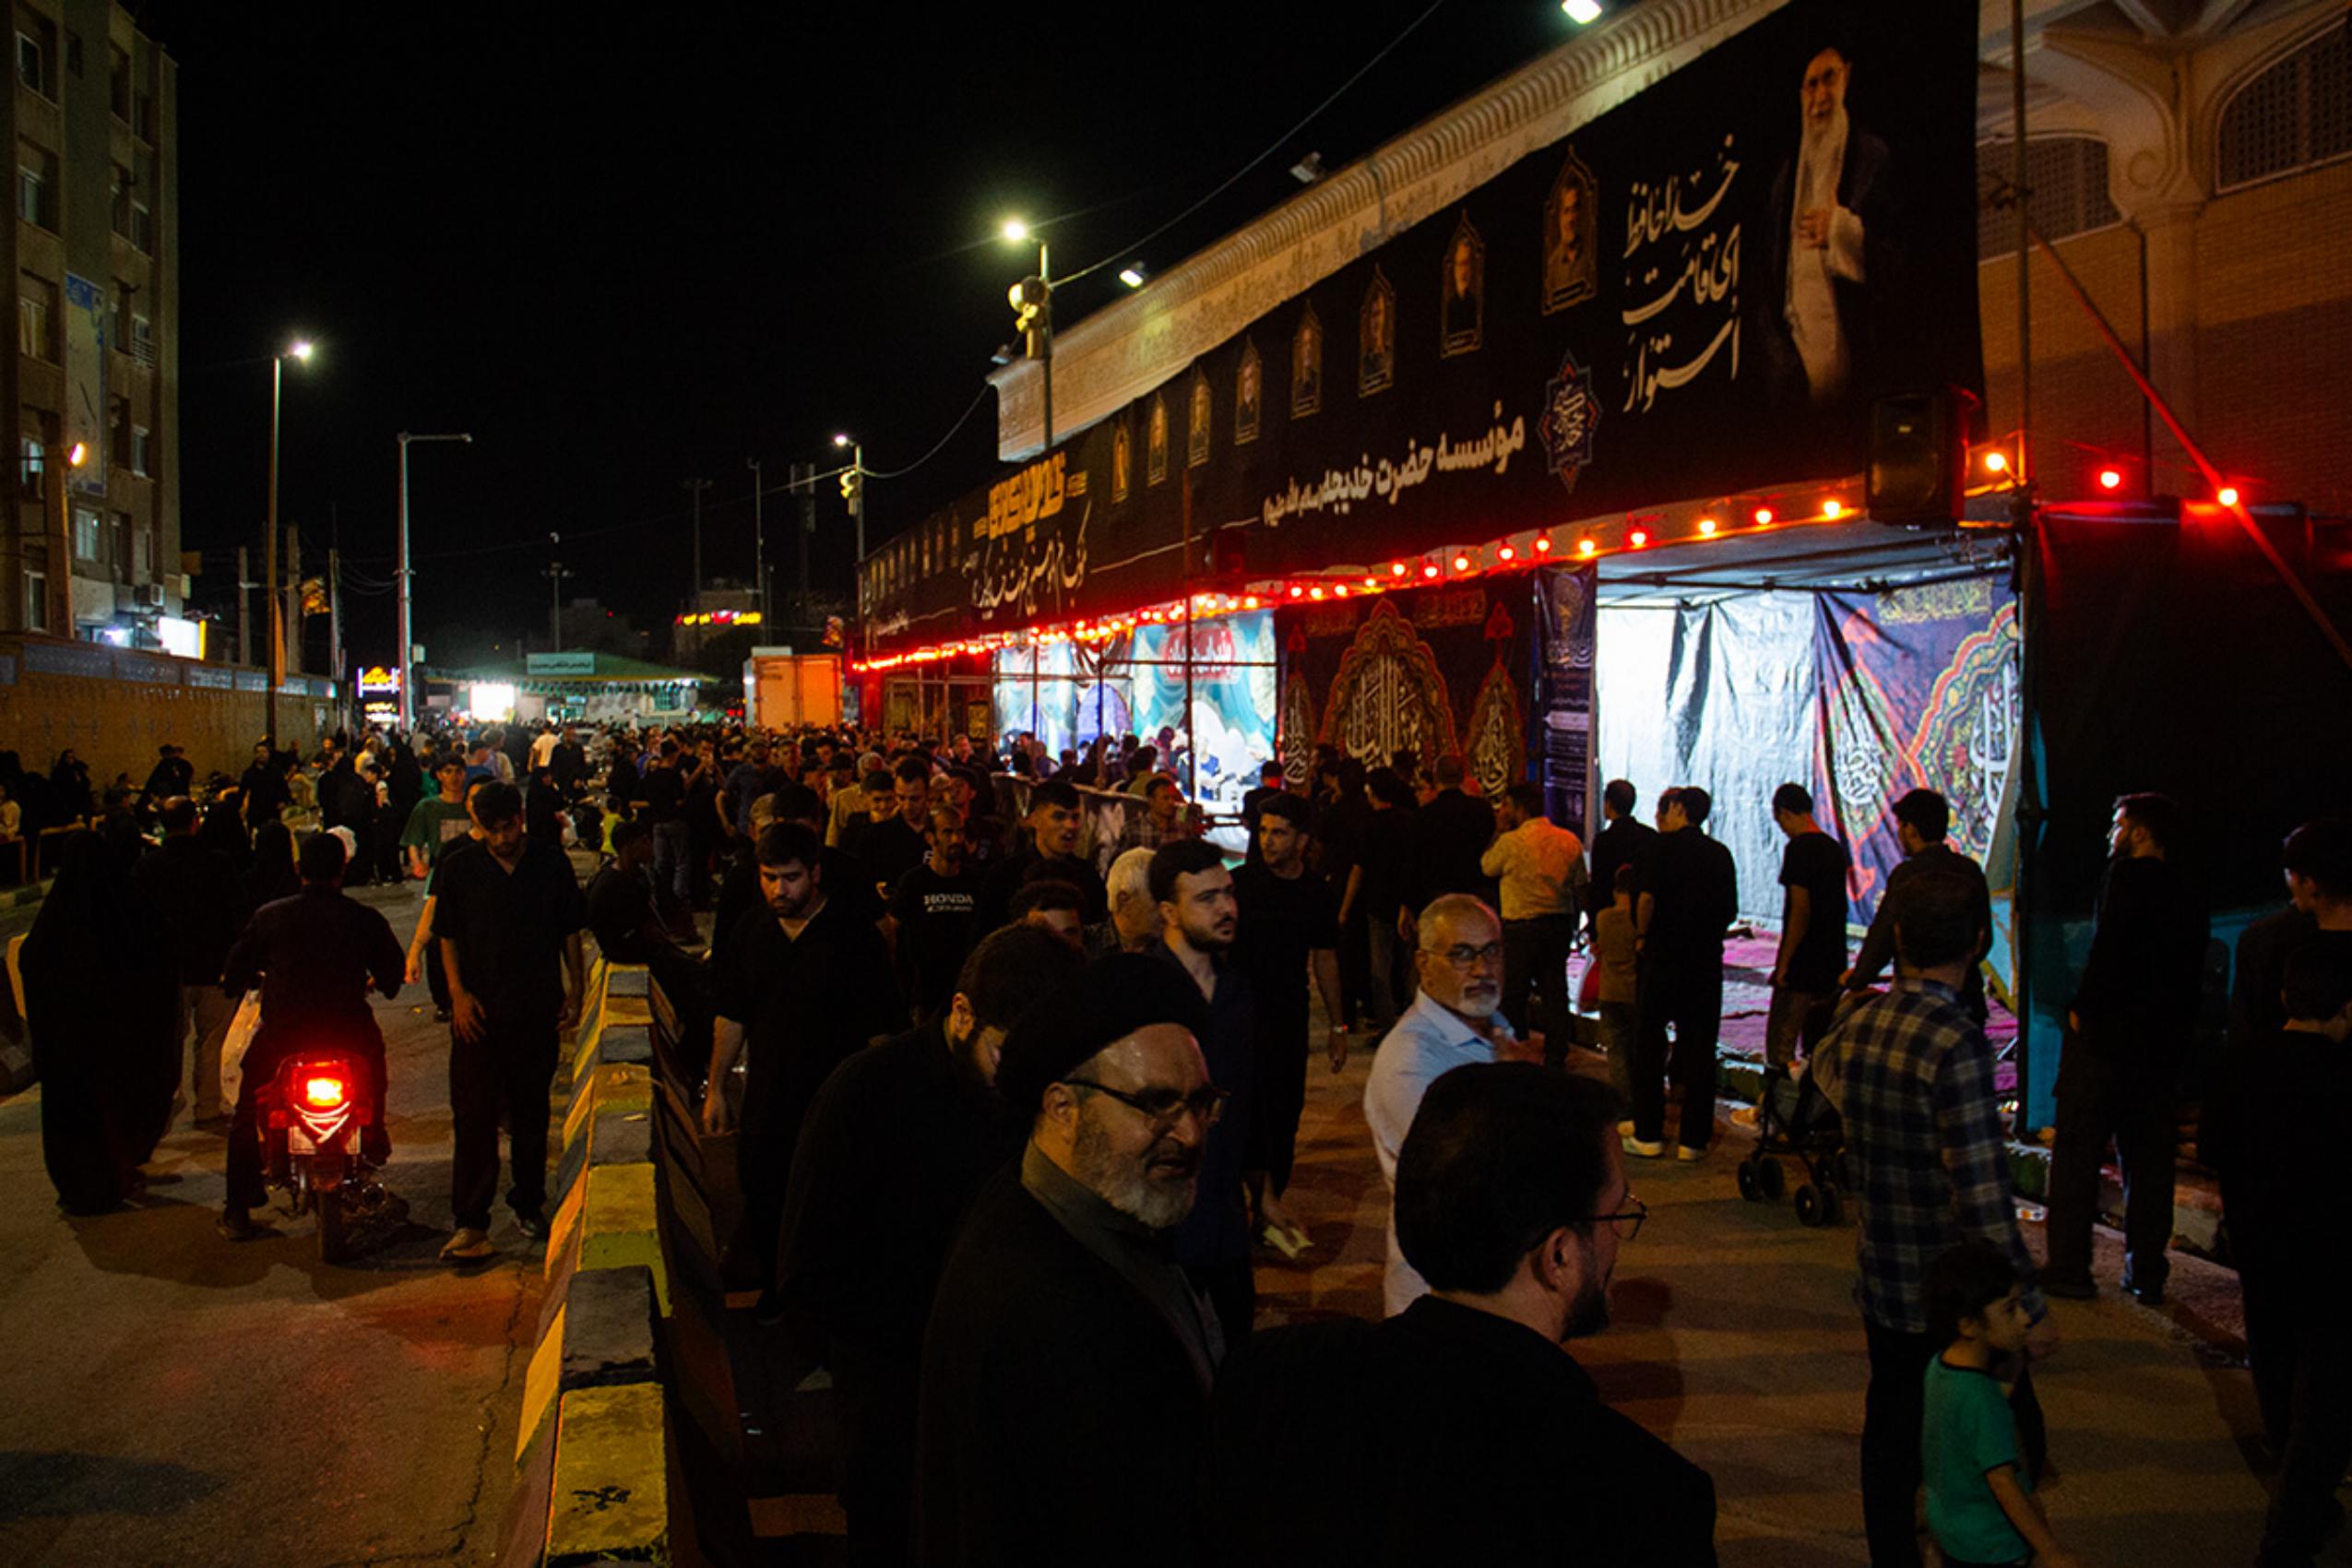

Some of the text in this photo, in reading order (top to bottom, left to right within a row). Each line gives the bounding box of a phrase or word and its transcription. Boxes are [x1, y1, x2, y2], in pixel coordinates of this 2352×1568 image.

[1622, 134, 1740, 259] خداحافظ
[1621, 222, 1740, 327] ای قامت
[1622, 315, 1740, 412] استوار
[1323, 452, 1376, 515] خدیجه
[1376, 438, 1435, 506] حضرت
[923, 893, 974, 906] HONDA
